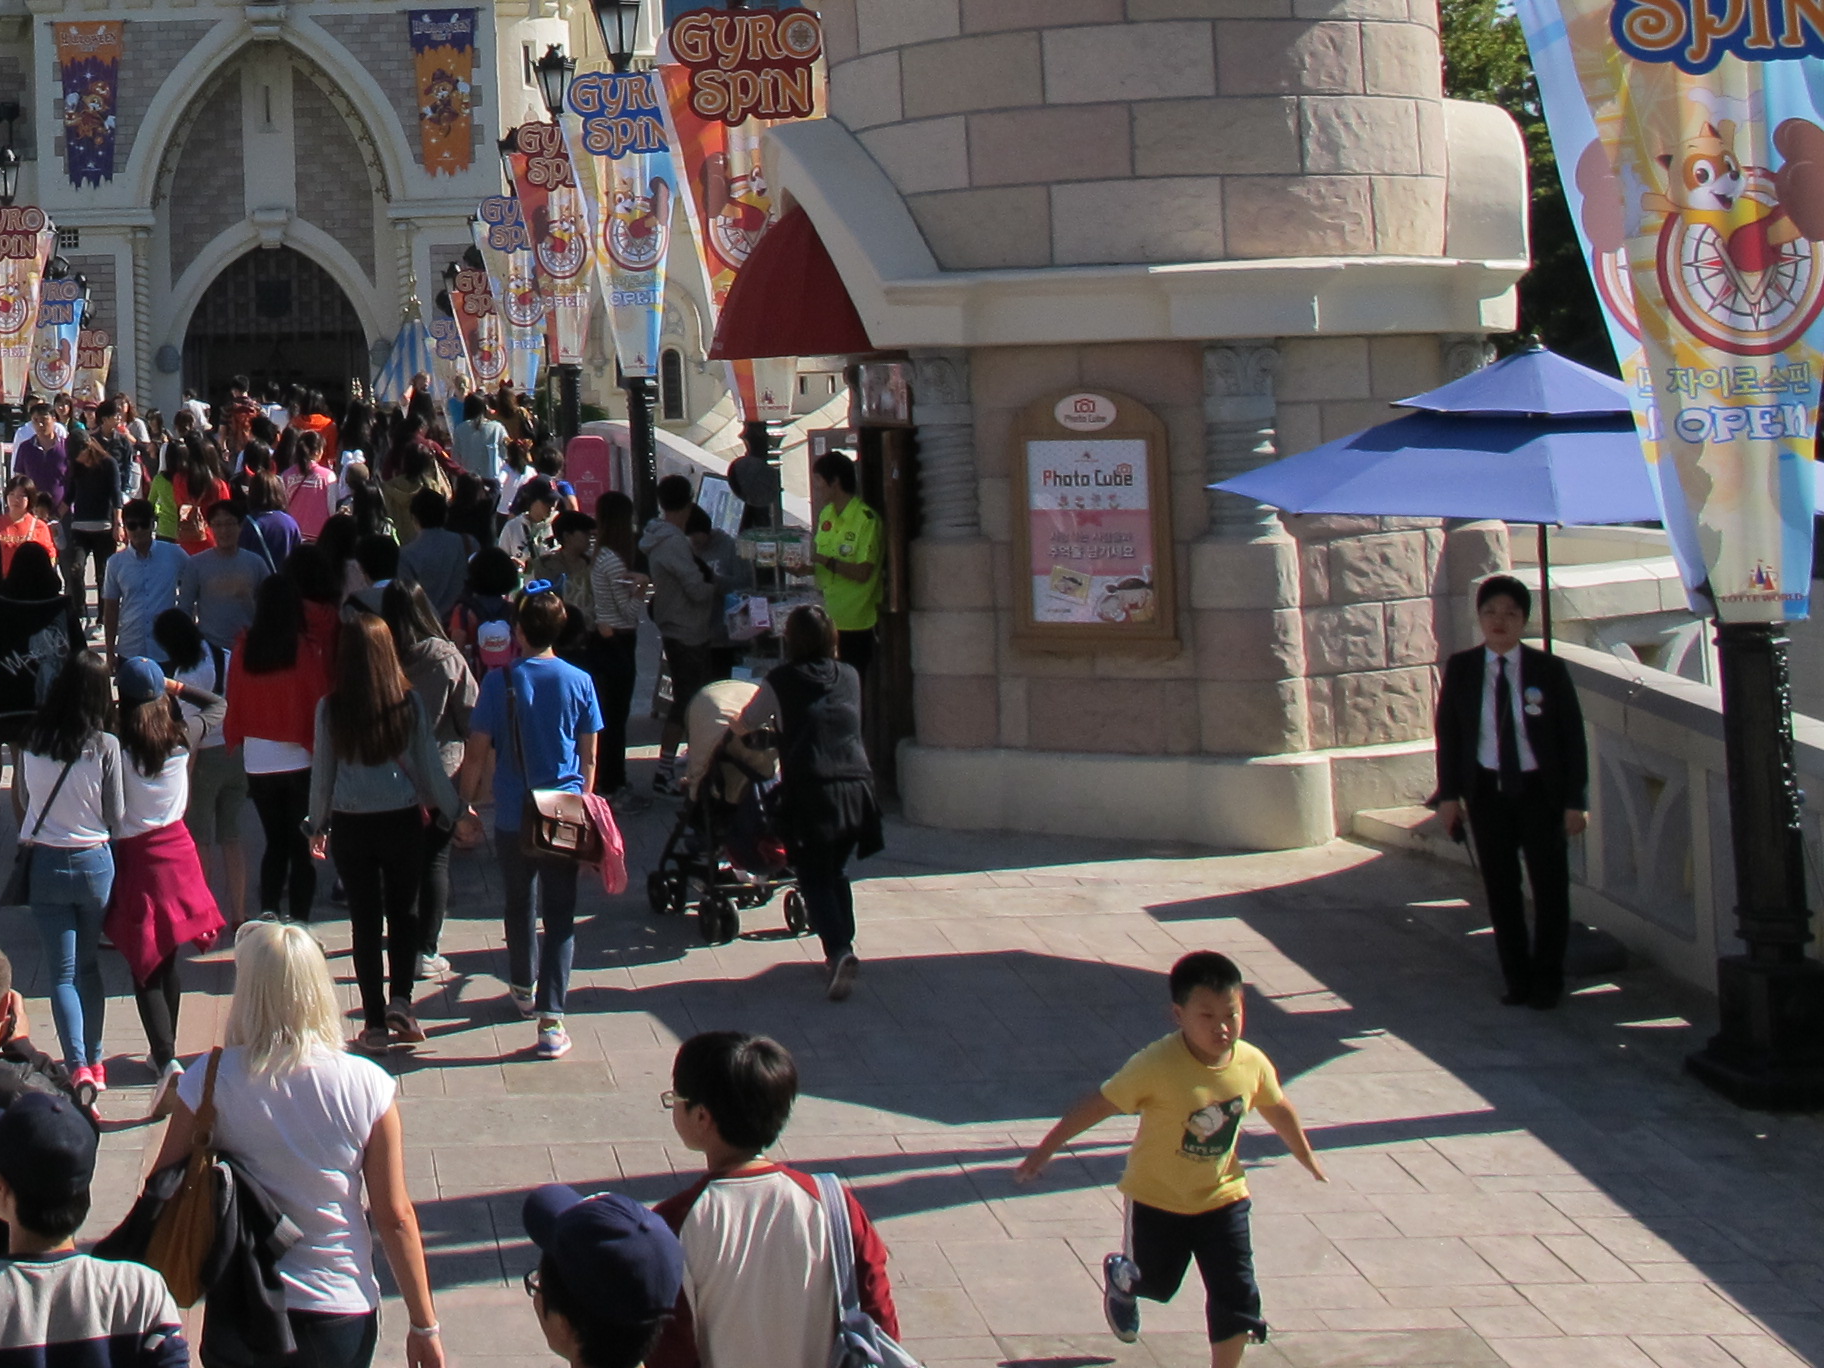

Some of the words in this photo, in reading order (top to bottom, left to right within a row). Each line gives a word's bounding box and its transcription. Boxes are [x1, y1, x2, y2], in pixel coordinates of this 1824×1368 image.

[673, 13, 822, 69] GYRO
[571, 76, 658, 117] GYR
[694, 67, 809, 121] SPIN
[1666, 362, 1811, 399] 자이로스핀
[1674, 401, 1812, 445] OPEN
[1043, 469, 1091, 487] Photo
[1094, 469, 1134, 487] Cube
